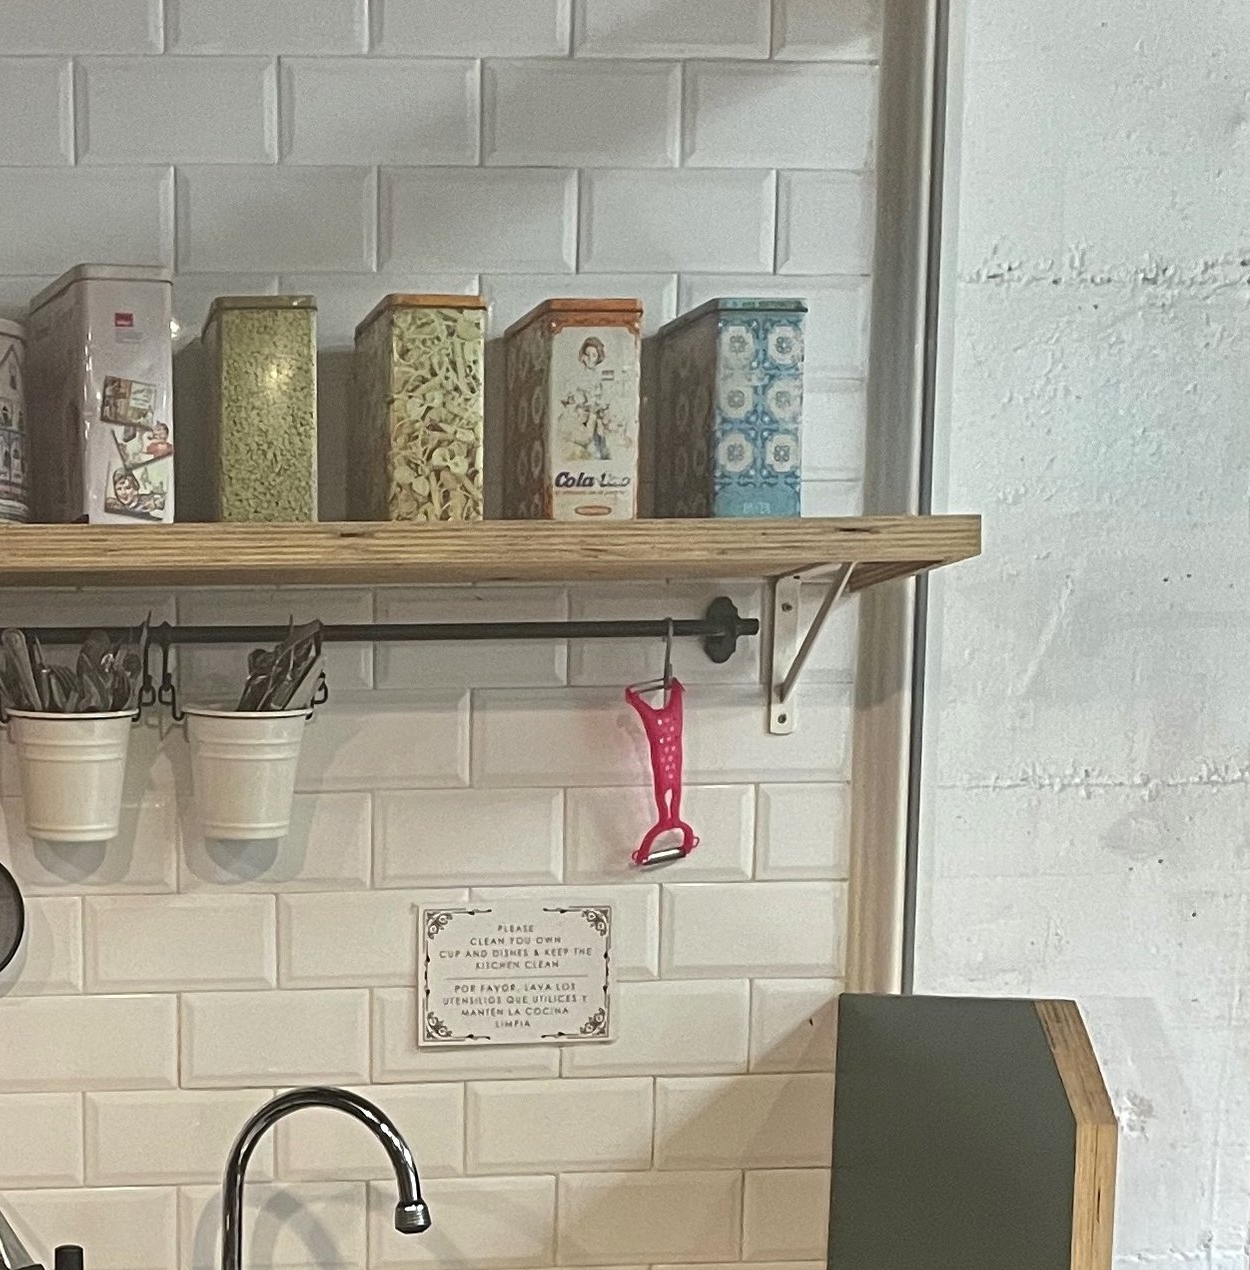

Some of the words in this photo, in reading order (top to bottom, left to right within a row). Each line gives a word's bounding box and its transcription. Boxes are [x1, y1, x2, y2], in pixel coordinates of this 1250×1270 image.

[554, 471, 595, 488] Cola
[497, 924, 535, 933] PLEASE
[469, 936, 505, 946] CLEAN
[509, 936, 532, 945] YOU
[535, 936, 562, 944] OWN
[439, 950, 461, 959] CUP
[465, 949, 488, 958] AND
[492, 948, 529, 957] DISHES
[534, 948, 540, 957] &
[544, 947, 569, 957] KEEP
[573, 947, 592, 956] THE
[475, 960, 520, 970] KITCHEN
[524, 960, 560, 969] CLEAN
[454, 984, 476, 993] POR
[524, 983, 553, 992] LAVA
[556, 982, 576, 991] LOS
[506, 995, 528, 1005] QUE
[532, 994, 578, 1004] UTILICES
[582, 994, 588, 1003] Y
[508, 1008, 521, 1016] LA
[524, 1006, 570, 1016] COCINA
[495, 1019, 531, 1028] LIMPIA
